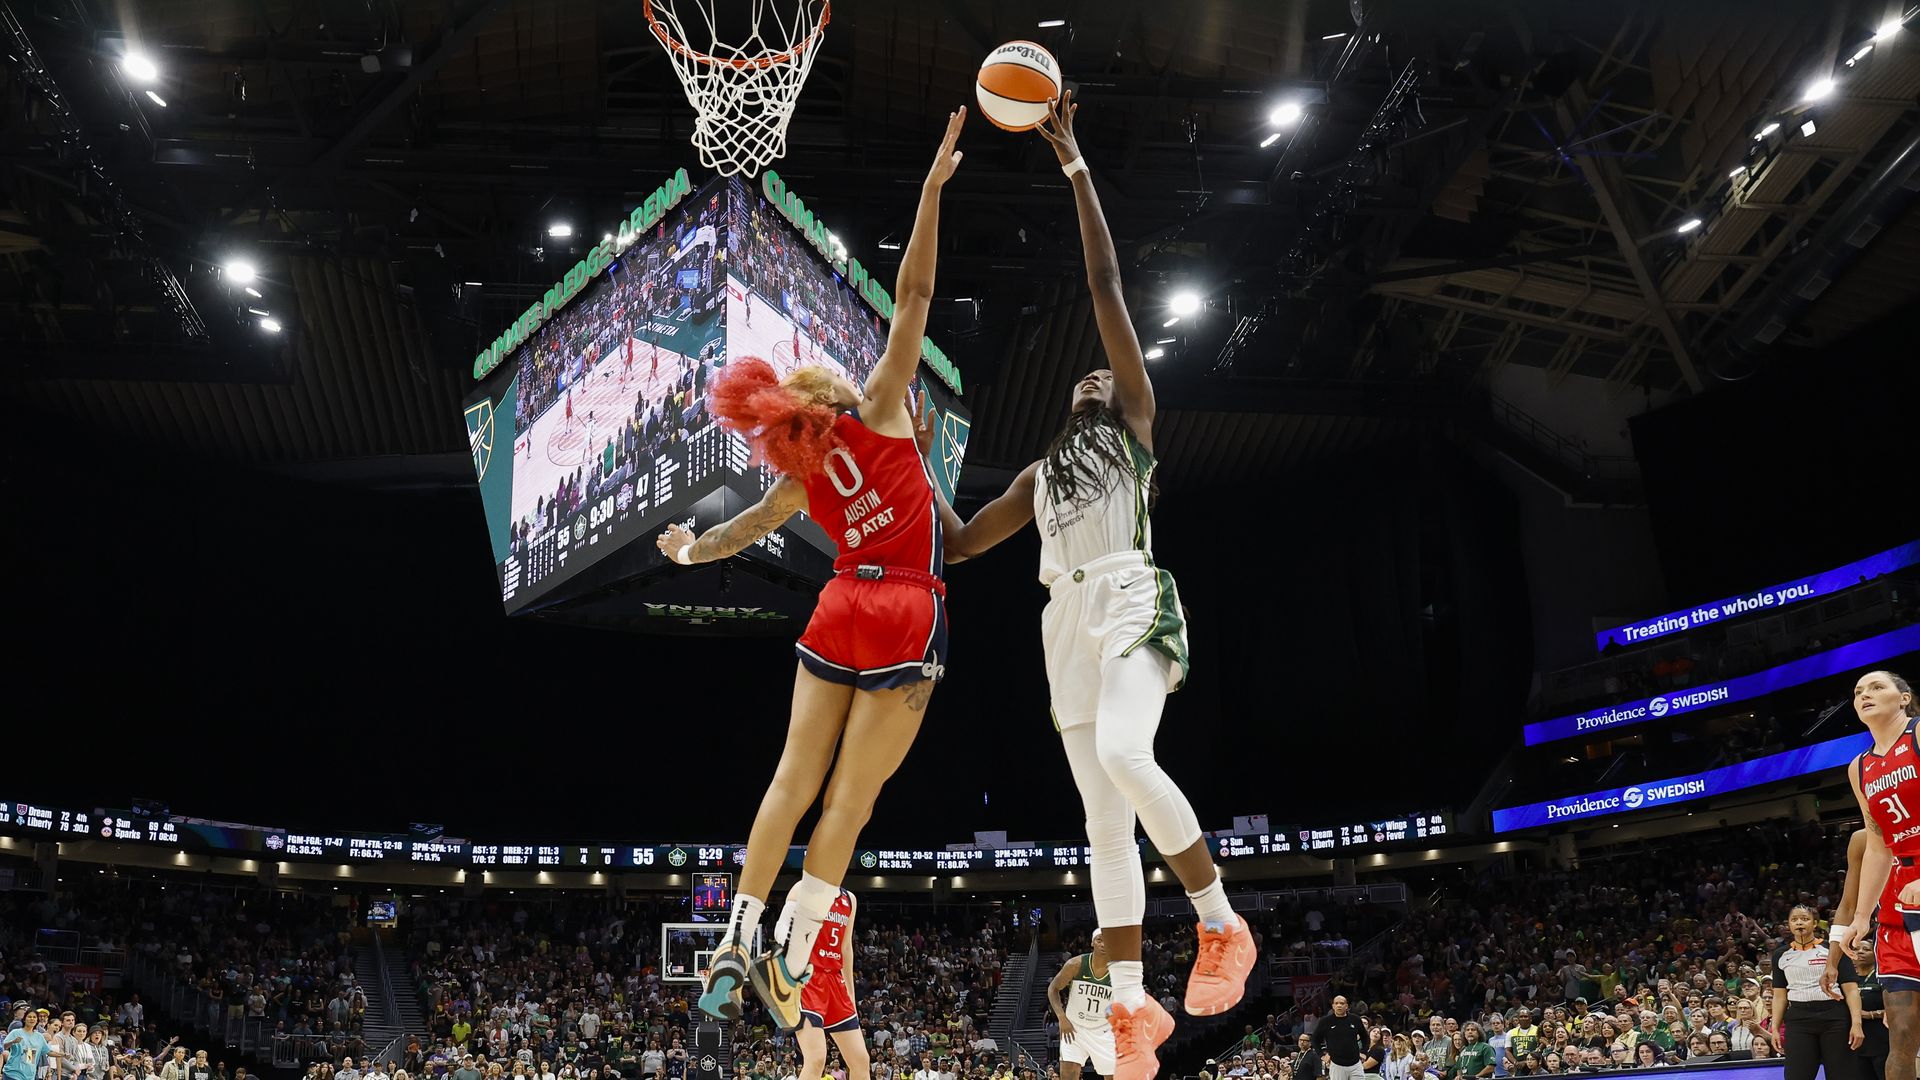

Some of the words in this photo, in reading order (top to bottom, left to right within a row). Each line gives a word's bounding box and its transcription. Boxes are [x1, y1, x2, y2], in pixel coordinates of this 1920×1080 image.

[997, 45, 1051, 72] Wilson
[473, 302, 543, 380] CLIMATE
[542, 236, 614, 318] PLEDGE
[616, 167, 691, 256] ARENA
[849, 257, 896, 324] PLED
[823, 447, 863, 498] 0
[636, 473, 649, 498] 47
[590, 496, 614, 528] 9:30
[844, 488, 882, 526] AUSTIN
[861, 507, 895, 537] AT&T
[557, 525, 570, 549] 55
[767, 540, 783, 559] Bank
[1623, 616, 1689, 641] Treating
[1691, 608, 1719, 624] the
[1722, 592, 1774, 616] whole
[1776, 583, 1814, 605] you.
[1576, 706, 1646, 730] Providence
[1672, 687, 1728, 709] SWEDISH
[1546, 796, 1620, 819] Providence
[1647, 780, 1705, 801] SWEDISH
[28, 806, 52, 819] Dream
[61, 811, 70, 821] 72
[76, 813, 87, 823] 4th
[1880, 793, 1910, 824] 31
[27, 817, 52, 830] Liberty
[60, 822, 69, 831] 79
[116, 818, 131, 829] Sun
[149, 822, 159, 831] 69
[163, 823, 174, 832] 4th
[1385, 820, 1407, 831] Wings
[1431, 815, 1442, 824] 4th
[115, 828, 141, 839] Sparks
[149, 832, 157, 841] 71
[1230, 837, 1244, 847] Sun
[1260, 835, 1269, 845] 69
[1274, 833, 1286, 842] 4th
[1311, 829, 1333, 840] Dream
[1341, 827, 1349, 837] 72
[1353, 825, 1365, 834] 4th
[1386, 831, 1405, 841] Fever
[1417, 828, 1427, 838] 102
[287, 835, 322, 845] FGM-FGA:
[324, 838, 343, 847] 17-47
[350, 839, 382, 849] FTM-FTA:
[383, 841, 403, 850] 12-18
[412, 842, 447, 853] 3PM-3PA:
[447, 844, 461, 854] 1-11
[472, 846, 489, 855] AST:
[489, 846, 498, 855] 12
[503, 846, 523, 855] DREB:
[524, 847, 533, 855] 21
[539, 847, 554, 855] STL:
[554, 847, 559, 855] 3
[1053, 848, 1070, 856] AST:
[1070, 847, 1078, 856] 11
[1230, 846, 1254, 857] Sparks
[1261, 845, 1269, 854] 71
[1312, 839, 1335, 850] Liberty
[1341, 837, 1350, 846] 79
[287, 844, 298, 854] FG:
[299, 846, 322, 855] 36.2%
[350, 848, 361, 858] FT:
[361, 850, 383, 859] 66.7%
[411, 852, 424, 861] 3P:
[472, 855, 487, 864] T/O:
[487, 855, 496, 864] 12
[503, 855, 523, 864] OREB:
[523, 855, 528, 864] 7
[538, 856, 554, 864] BLK:
[554, 856, 559, 864] 2
[580, 855, 587, 865] 4
[604, 855, 611, 865] 0
[633, 848, 654, 865] 55
[698, 848, 723, 860] 9:29
[879, 850, 911, 860] FGM-FGA:
[912, 851, 933, 860] 20-52
[937, 851, 967, 860] FTM-FTA:
[967, 851, 983, 859] 8-10
[995, 848, 1028, 859] 3PM-3PA:
[1028, 848, 1043, 857] 7-14
[1054, 857, 1069, 866] T/O:
[1069, 856, 1078, 865] 10
[879, 860, 890, 869] FG:
[890, 860, 913, 869] 38.5%
[937, 860, 948, 869] FT:
[947, 860, 969, 869] 80.0%
[994, 858, 1007, 868] 3P:
[1007, 858, 1029, 867] 50.0%
[829, 927, 839, 947] 5
[1078, 984, 1112, 1000] STORM
